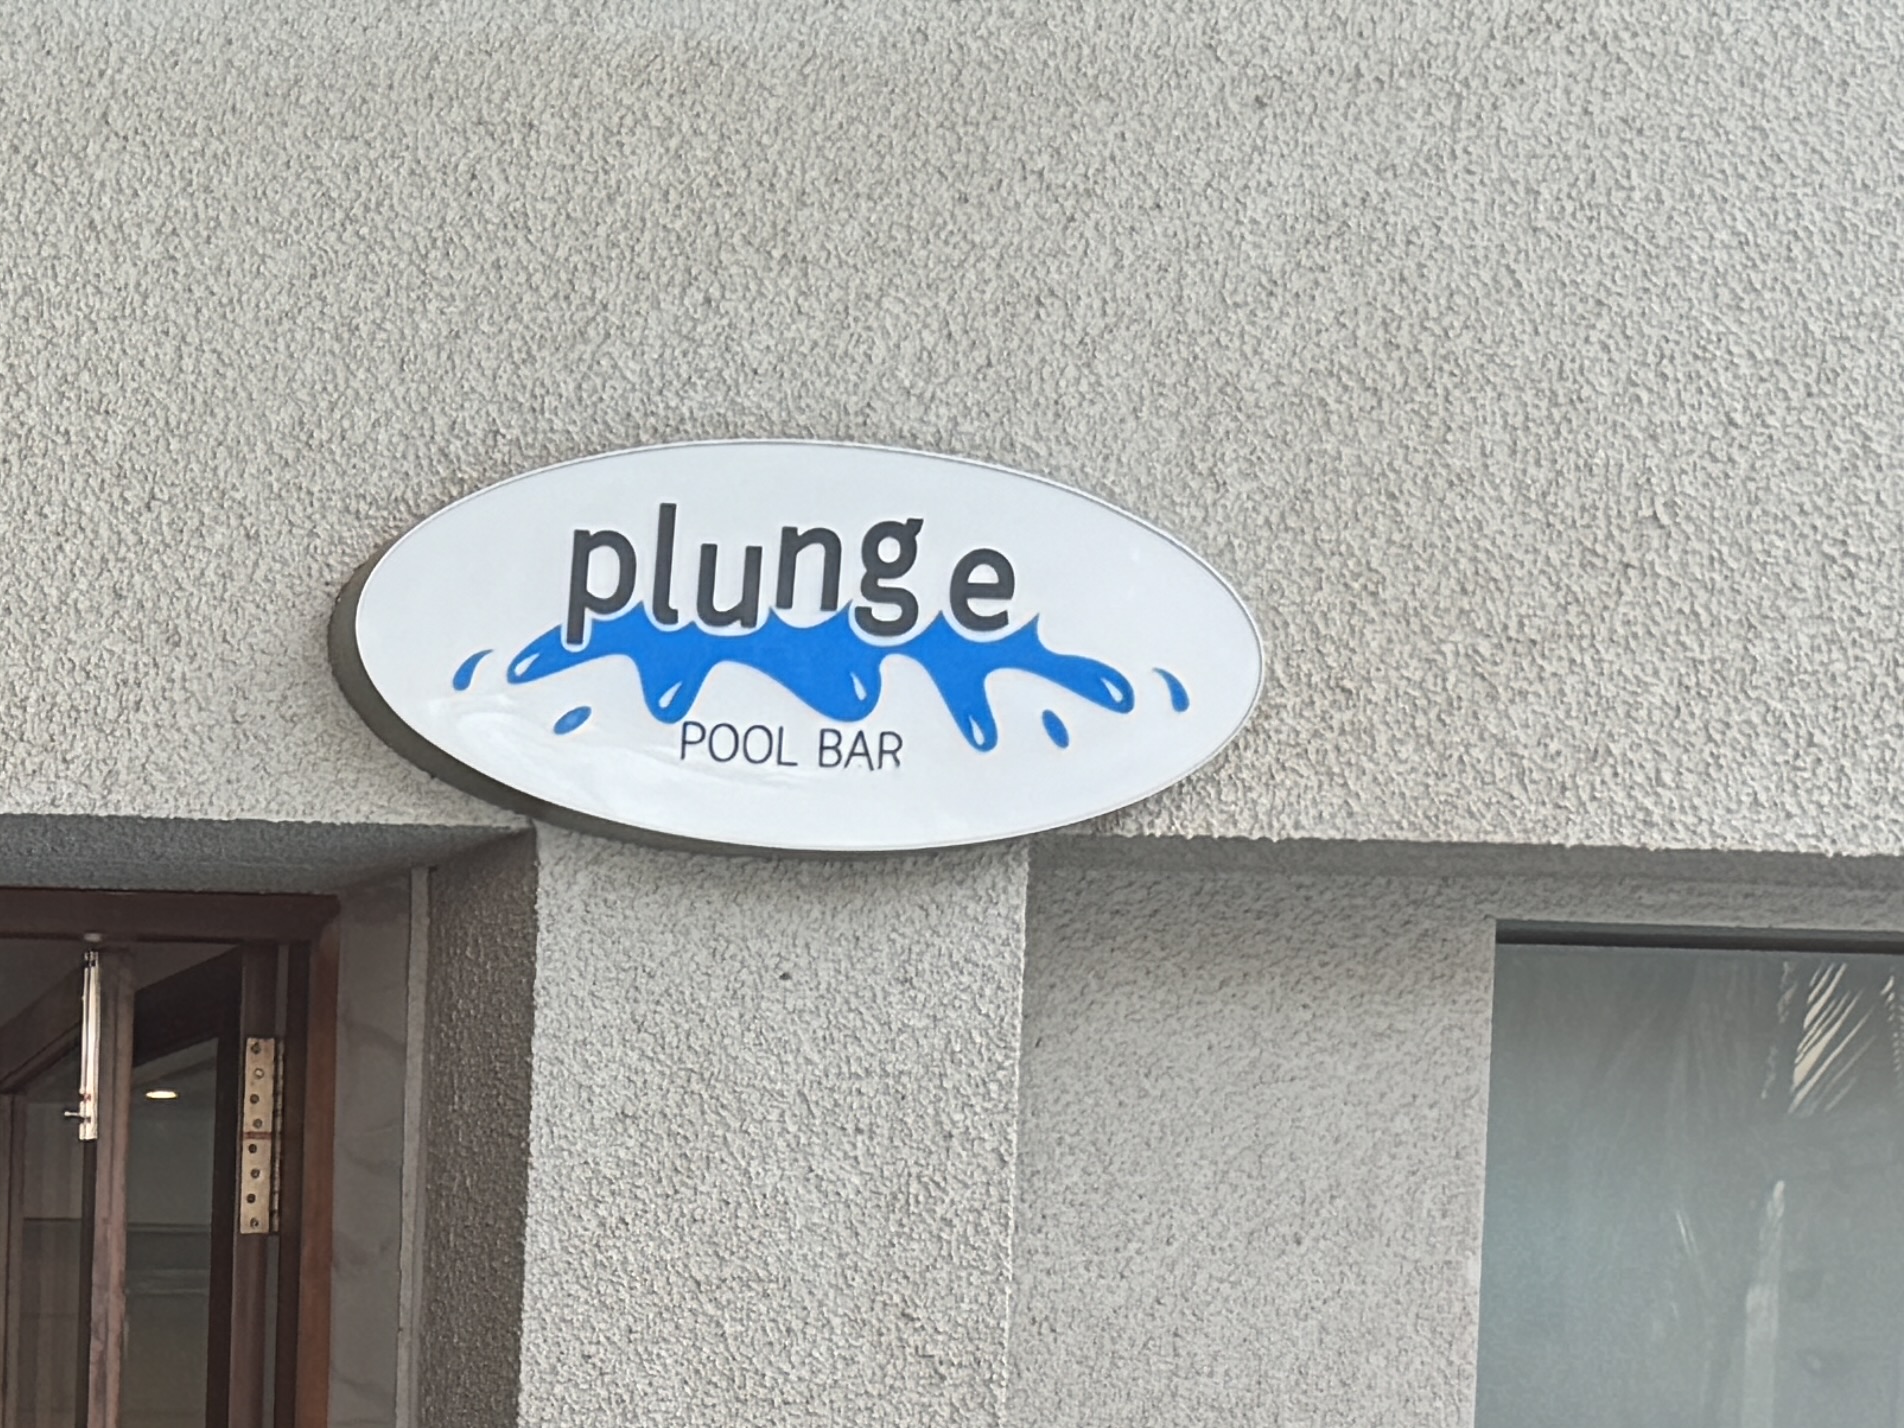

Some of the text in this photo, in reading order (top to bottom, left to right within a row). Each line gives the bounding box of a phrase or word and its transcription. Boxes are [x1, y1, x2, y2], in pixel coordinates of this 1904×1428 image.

[565, 503, 1016, 645] plunge
[681, 721, 904, 771] POOL BAR
